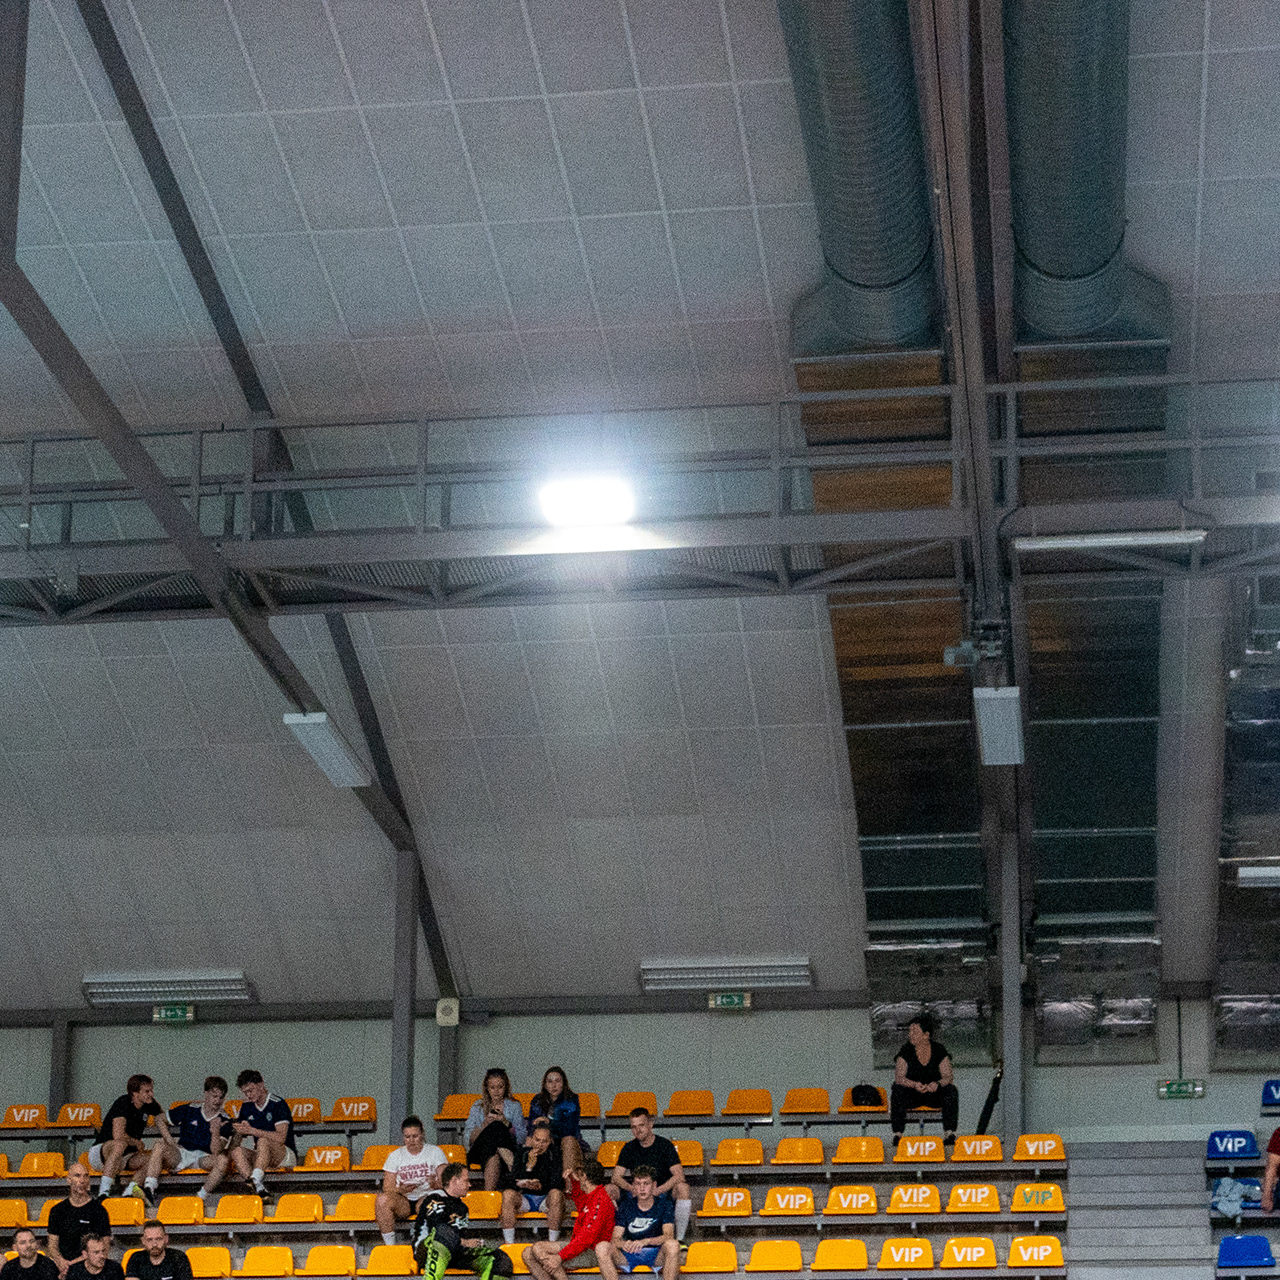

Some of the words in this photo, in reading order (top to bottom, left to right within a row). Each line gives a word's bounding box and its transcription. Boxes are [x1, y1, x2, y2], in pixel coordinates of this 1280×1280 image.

[12, 1108, 39, 1122] VIP
[67, 1107, 94, 1121] VIP
[342, 1102, 369, 1116] VIP
[906, 1140, 936, 1156] VIP
[963, 1140, 993, 1155] VIP
[1025, 1140, 1056, 1155] VIP
[1215, 1136, 1246, 1153] VIP
[313, 1149, 342, 1164] VIP
[714, 1192, 745, 1207] VIP
[776, 1193, 807, 1209] VIP
[839, 1193, 870, 1208] VIP
[898, 1187, 931, 1203] VIP
[959, 1187, 990, 1203] VIP
[1022, 1190, 1053, 1205] VIP
[890, 1246, 923, 1262] VIP
[952, 1246, 985, 1262] VIP
[1019, 1245, 1052, 1261] VIP
